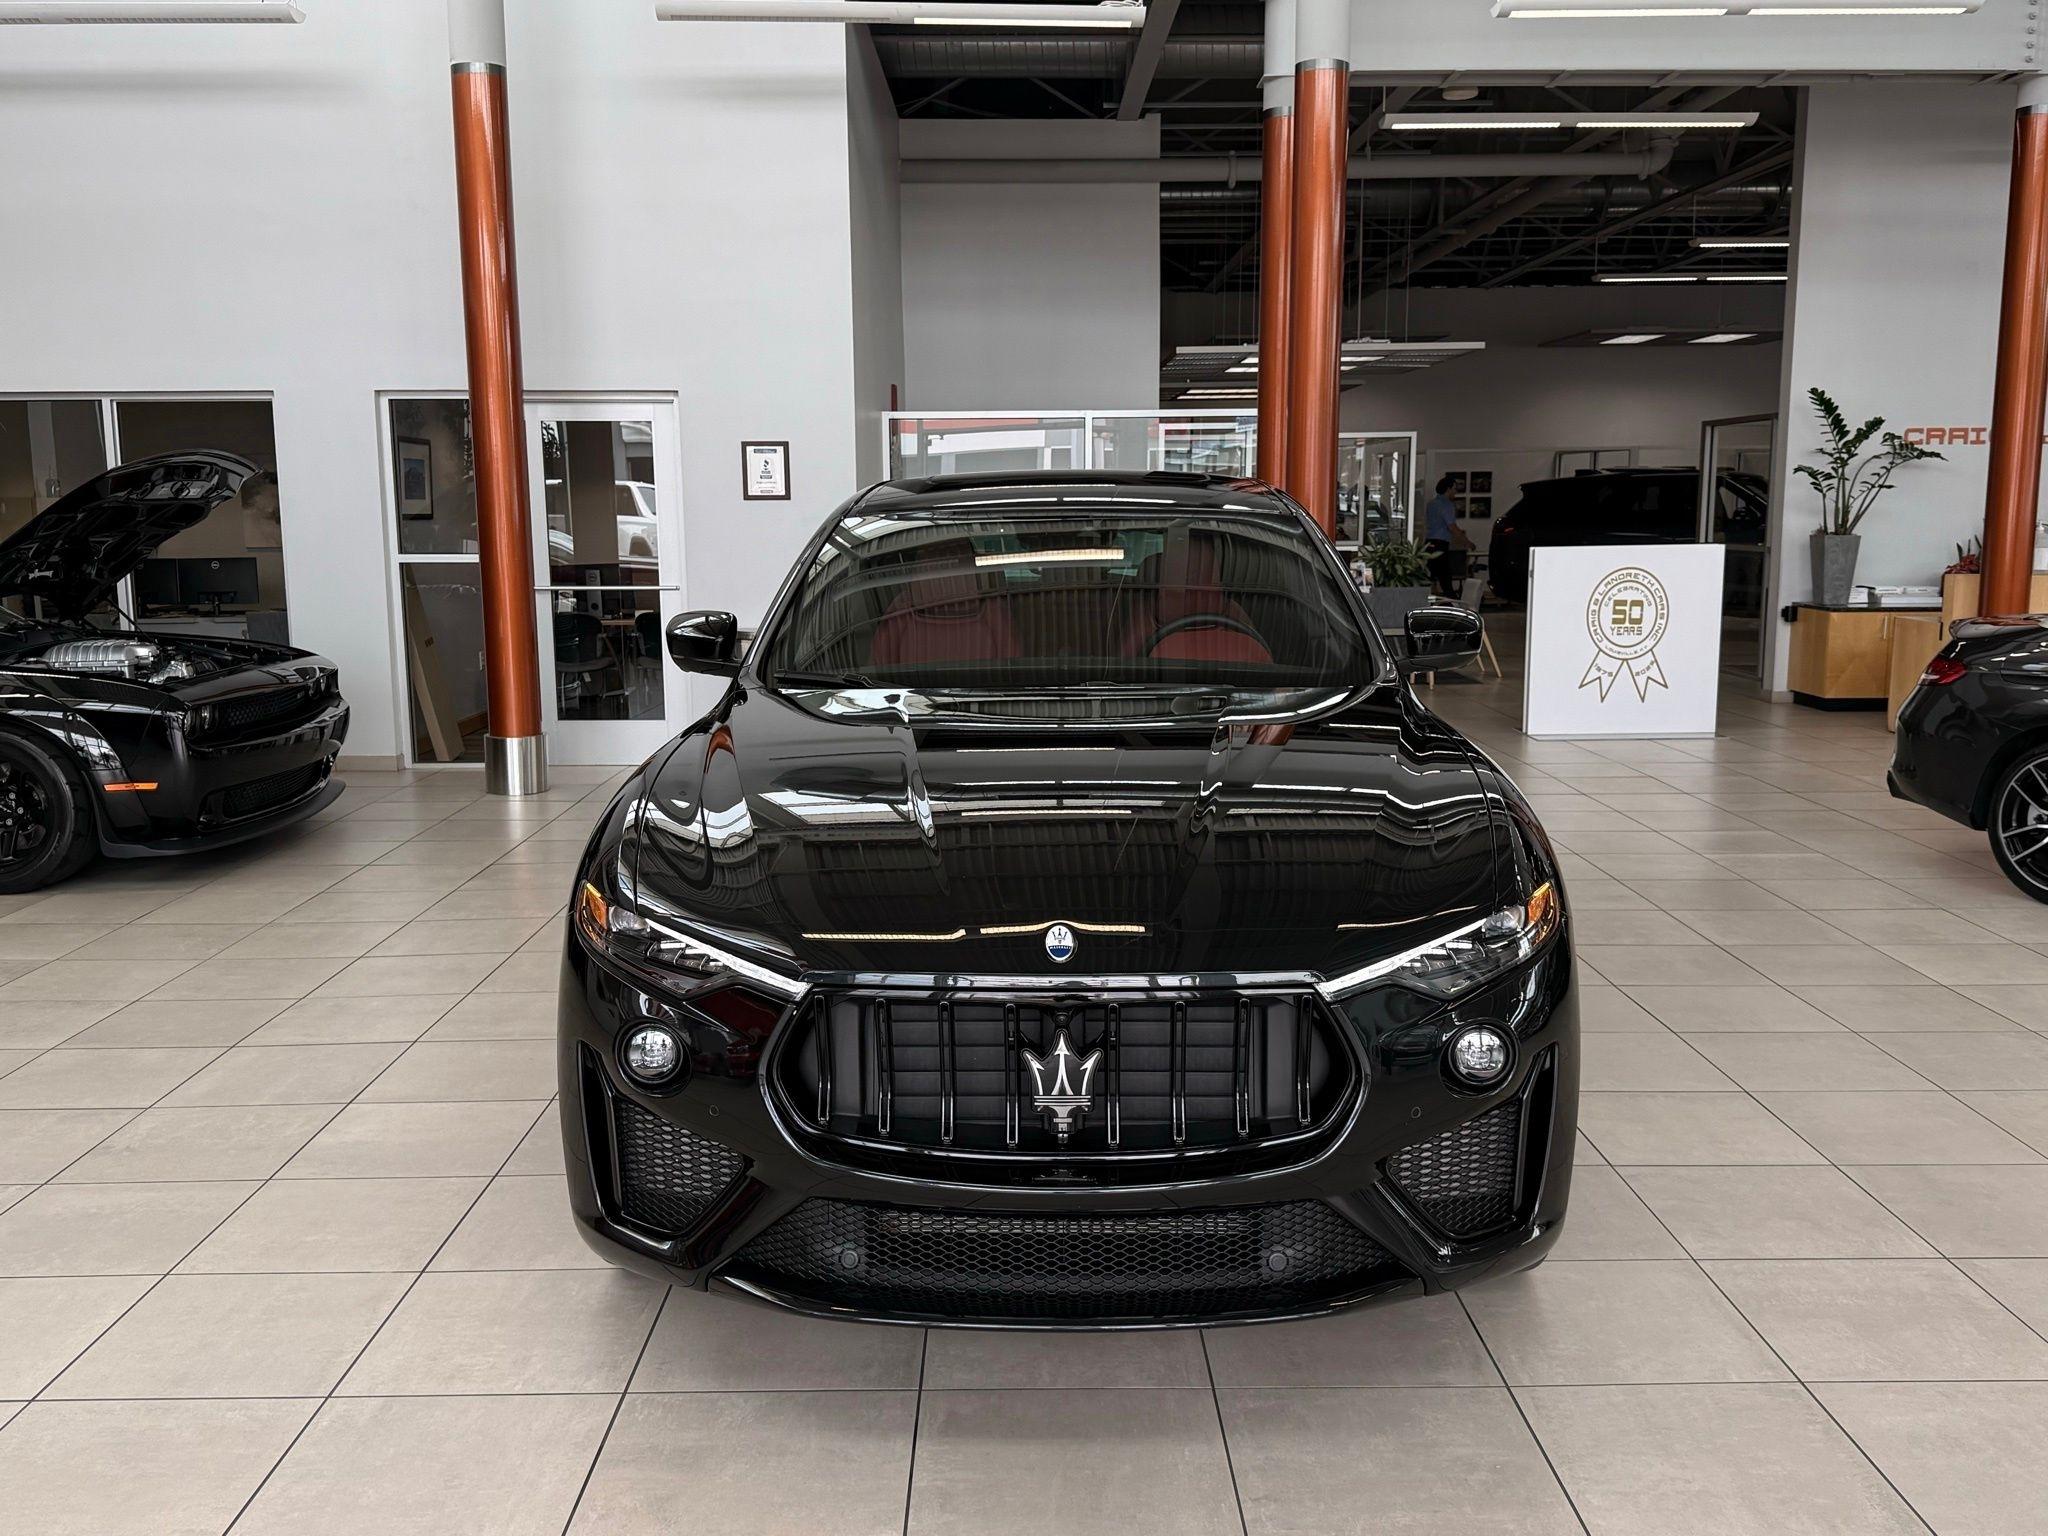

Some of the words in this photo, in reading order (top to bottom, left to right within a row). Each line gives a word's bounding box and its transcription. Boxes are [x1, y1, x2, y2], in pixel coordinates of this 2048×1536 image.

[1904, 427, 1992, 445] CRAI
[1604, 585, 1652, 607] CELEBRATING
[1590, 609, 1604, 643] CRAIG
[1598, 572, 1655, 596] LANDRETH
[1653, 587, 1666, 620] CARS
[1611, 599, 1645, 625] 50
[1610, 626, 1643, 636] YEARS
